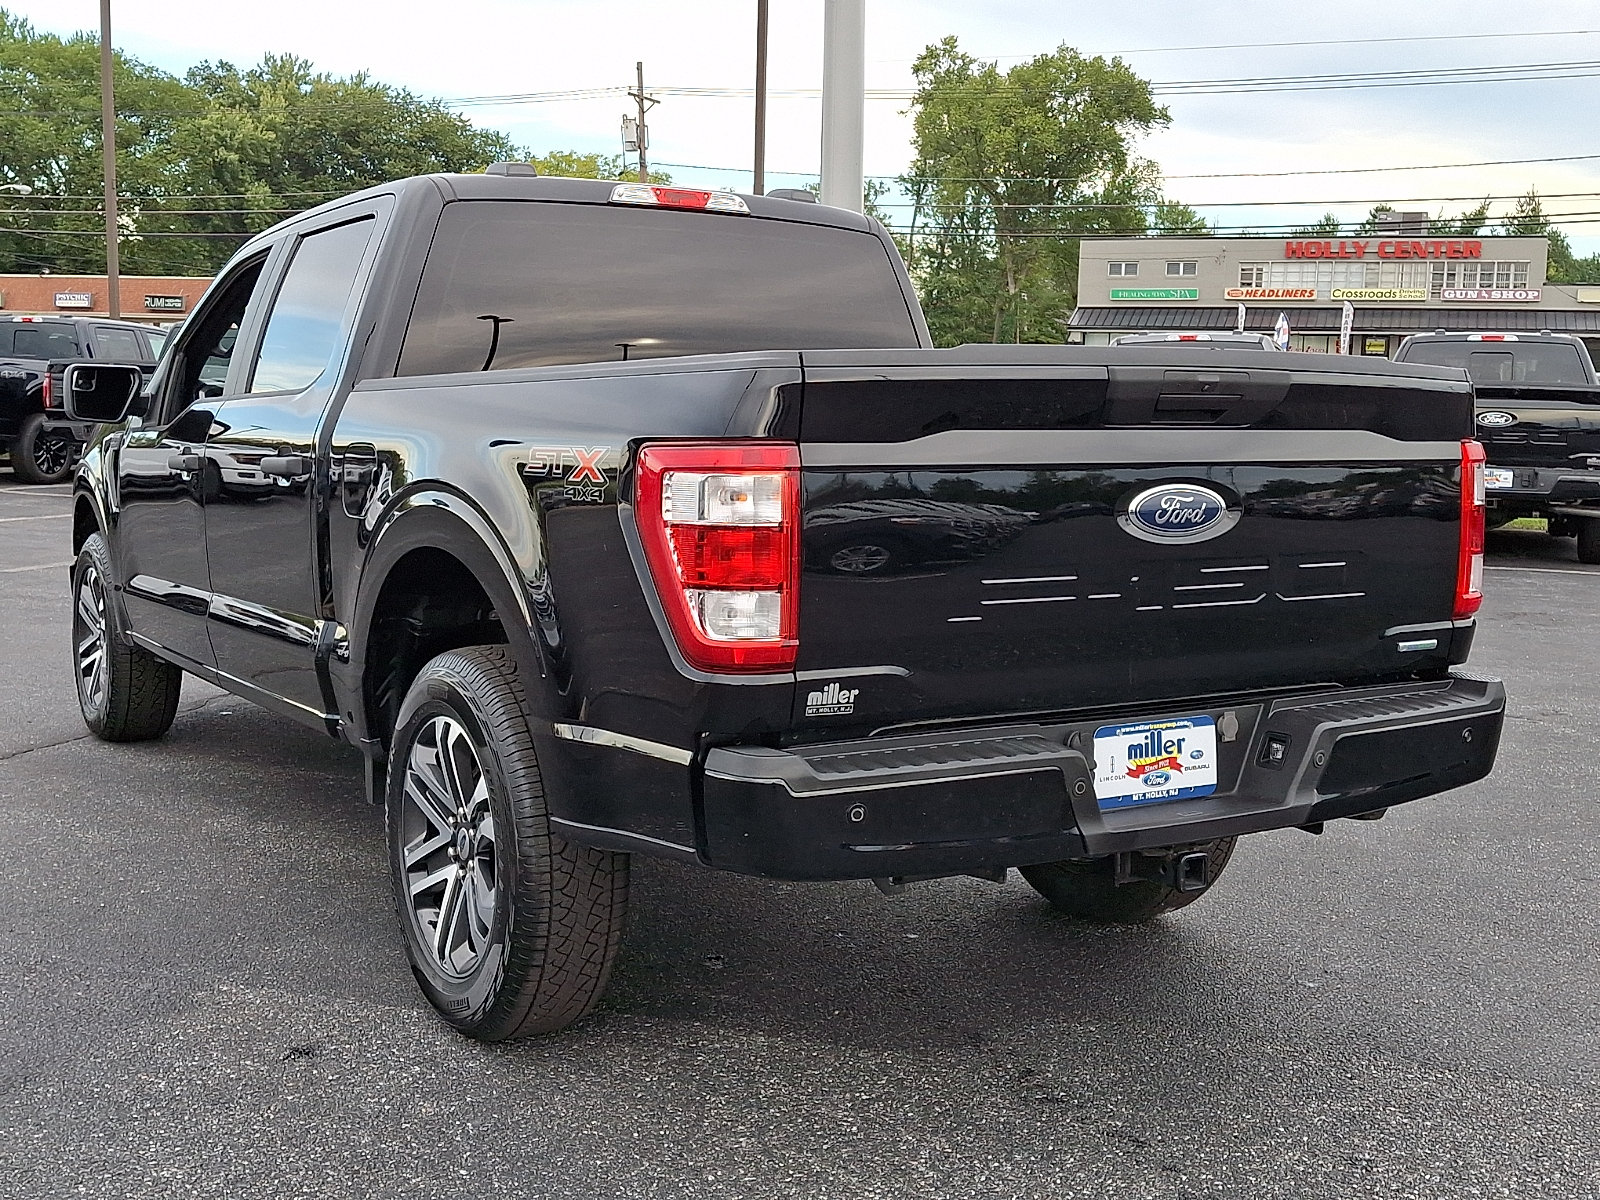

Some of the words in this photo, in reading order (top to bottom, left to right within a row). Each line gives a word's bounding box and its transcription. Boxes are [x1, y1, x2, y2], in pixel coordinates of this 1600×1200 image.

[1285, 241, 1370, 258] HOLLY
[1378, 241, 1482, 258] CENTER
[56, 293, 89, 301] PSYCHIC
[1169, 289, 1191, 298] SPA
[1245, 289, 1316, 298] HEADLINERS
[1332, 289, 1397, 299] Crossroads
[1444, 290, 1479, 299] GUN
[1491, 290, 1539, 299] SHOP
[144, 297, 164, 307] RUMI
[1484, 414, 1507, 423] Ford
[523, 445, 611, 488] STX
[1155, 495, 1207, 524] Ford
[806, 682, 860, 706] miller
[1128, 730, 1186, 760] miller
[1144, 764, 1159, 773] Since
[1184, 763, 1210, 771] SUBARU
[1099, 774, 1126, 783] LINCOLN
[1147, 772, 1166, 785] Ford
[1132, 793, 1145, 801] MT.
[1145, 790, 1168, 800] HOLLY,
[1169, 788, 1179, 797] NJ
